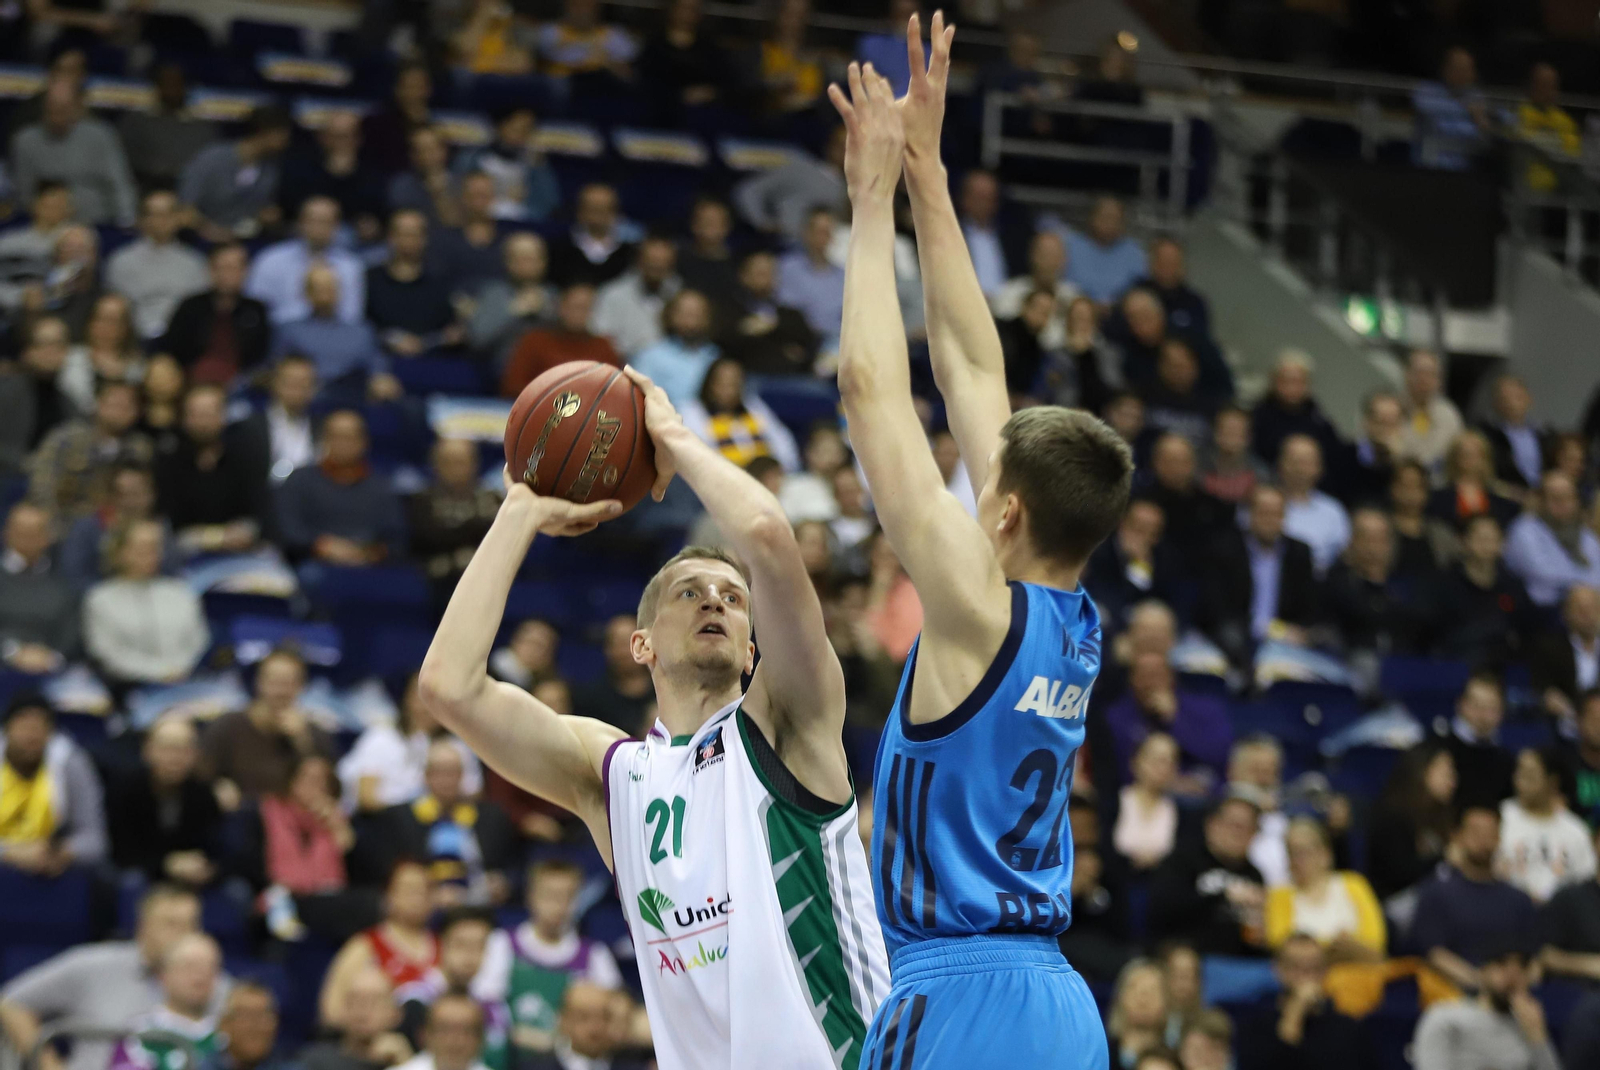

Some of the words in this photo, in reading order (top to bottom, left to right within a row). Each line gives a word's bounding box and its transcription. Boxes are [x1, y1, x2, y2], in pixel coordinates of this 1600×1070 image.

[563, 410, 622, 502] SPALD
[645, 795, 686, 865] 21
[674, 892, 732, 928] Unic
